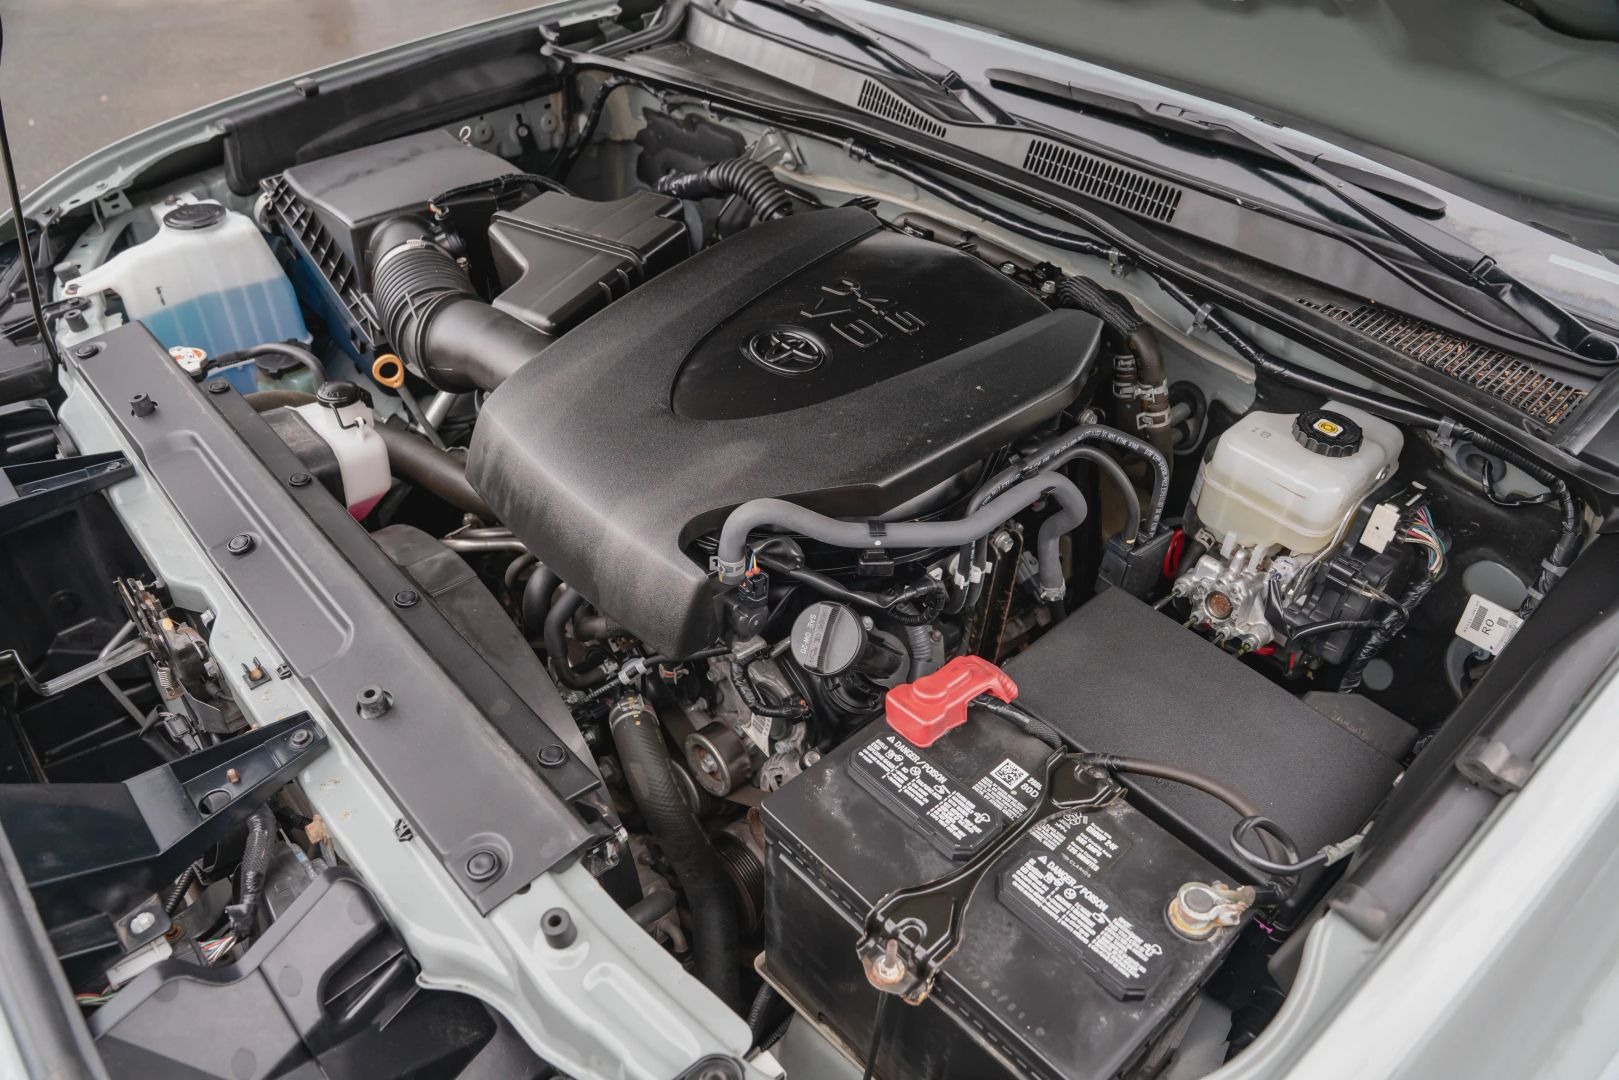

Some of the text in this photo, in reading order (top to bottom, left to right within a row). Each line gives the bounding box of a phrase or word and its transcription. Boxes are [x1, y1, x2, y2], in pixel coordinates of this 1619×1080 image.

[800, 613, 817, 654] SAE 0W-20
[1481, 618, 1495, 636] RO
[1020, 782, 1039, 798] 80D
[1069, 859, 1091, 879] CLARIOS
